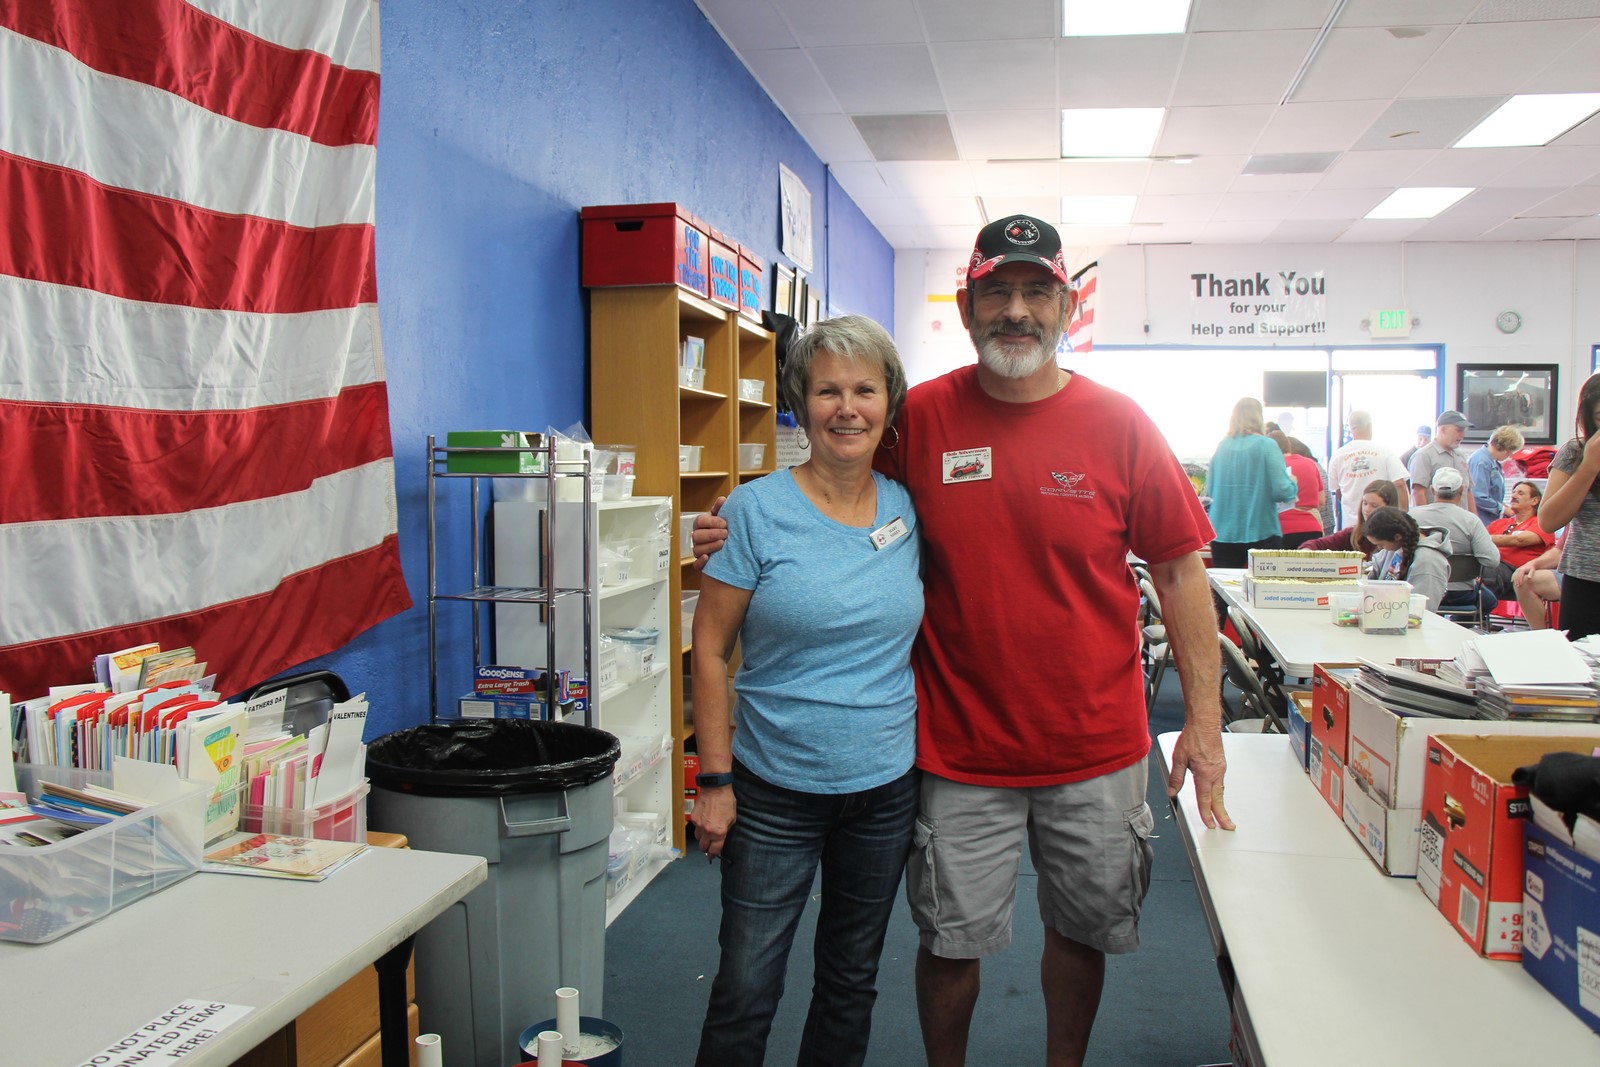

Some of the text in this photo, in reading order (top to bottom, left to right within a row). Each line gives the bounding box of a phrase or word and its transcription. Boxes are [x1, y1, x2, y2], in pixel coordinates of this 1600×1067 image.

[685, 225, 700, 251] FOR
[685, 247, 700, 271] THE
[711, 255, 724, 275] FOR
[678, 263, 706, 295] TROOPS
[712, 277, 737, 303] TROOPS
[1191, 271, 1325, 297] Thank You
[1230, 302, 1286, 316] for your
[1379, 310, 1406, 330] EXIT
[1191, 322, 1326, 338] Help and Support!!
[1040, 486, 1096, 496] CORVETTE
[1364, 595, 1408, 619] Crayon
[248, 695, 286, 713] FATHERS DAY
[333, 711, 367, 720] VALENTINES
[1509, 803, 1528, 814] STA
[1512, 914, 1522, 926] 9
[108, 1032, 147, 1054] NOT
[144, 1004, 195, 1032] PLACE
[113, 1003, 226, 1067] ONATED ITEMS
[167, 1028, 218, 1058] HERE!
